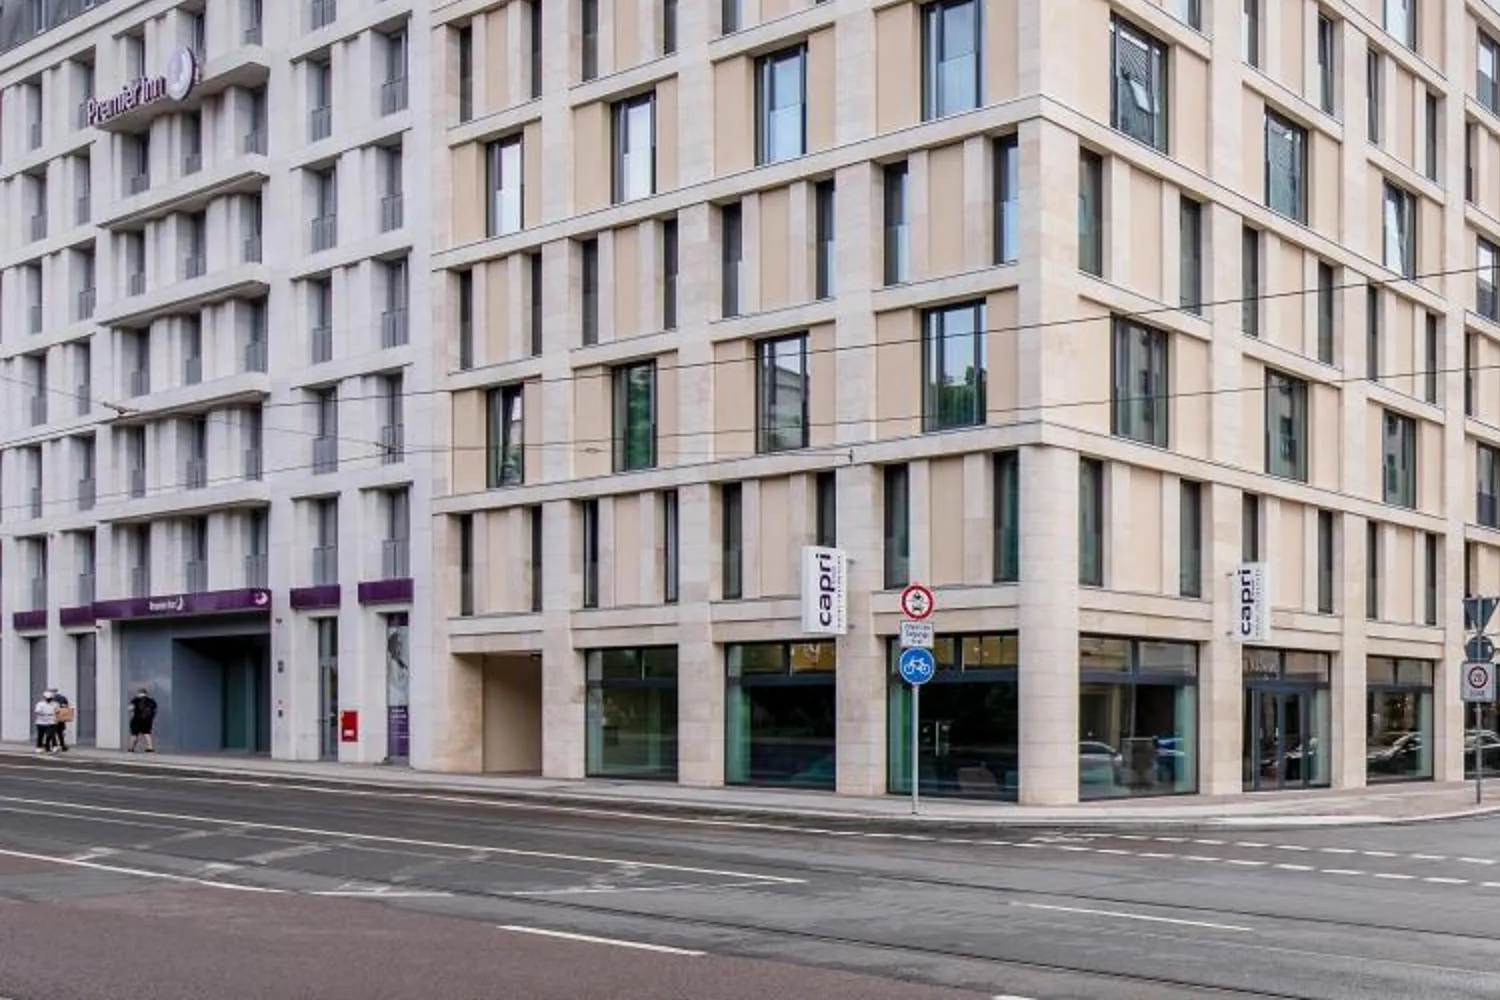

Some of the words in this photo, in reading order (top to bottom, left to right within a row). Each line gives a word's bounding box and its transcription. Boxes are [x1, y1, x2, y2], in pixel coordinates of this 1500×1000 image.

[88, 79, 142, 126] Premier
[140, 72, 167, 104] Inn
[816, 553, 835, 627] capri
[1238, 569, 1255, 635] capri
